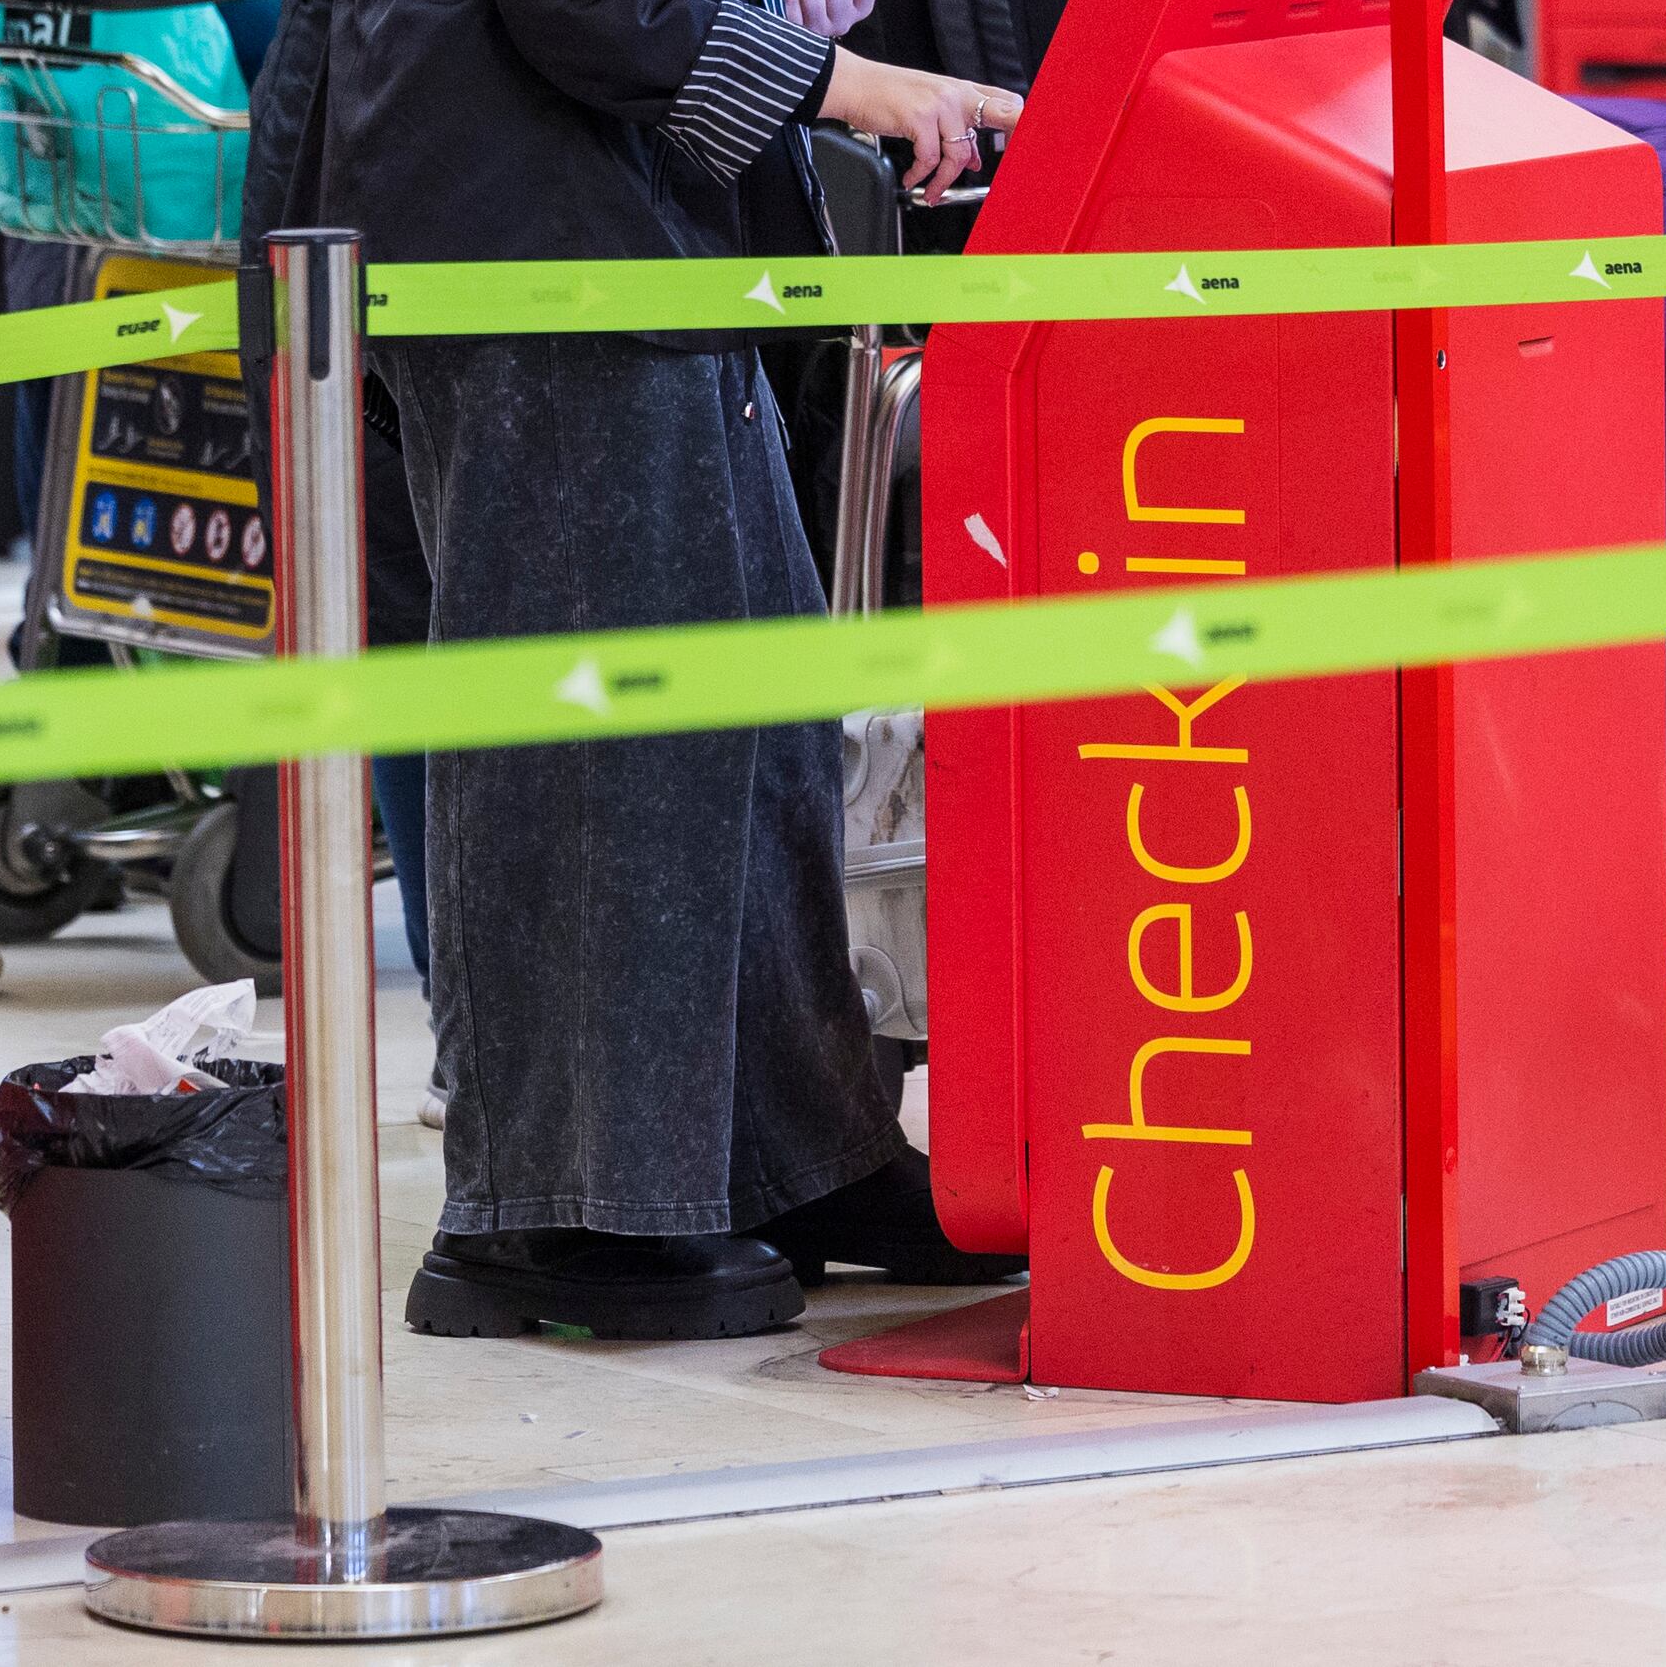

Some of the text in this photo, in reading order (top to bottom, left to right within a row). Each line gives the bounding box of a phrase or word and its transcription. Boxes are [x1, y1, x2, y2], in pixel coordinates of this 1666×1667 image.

[1603, 261, 1643, 275] aena
[1201, 277, 1240, 290] aena
[782, 285, 823, 298] aena
